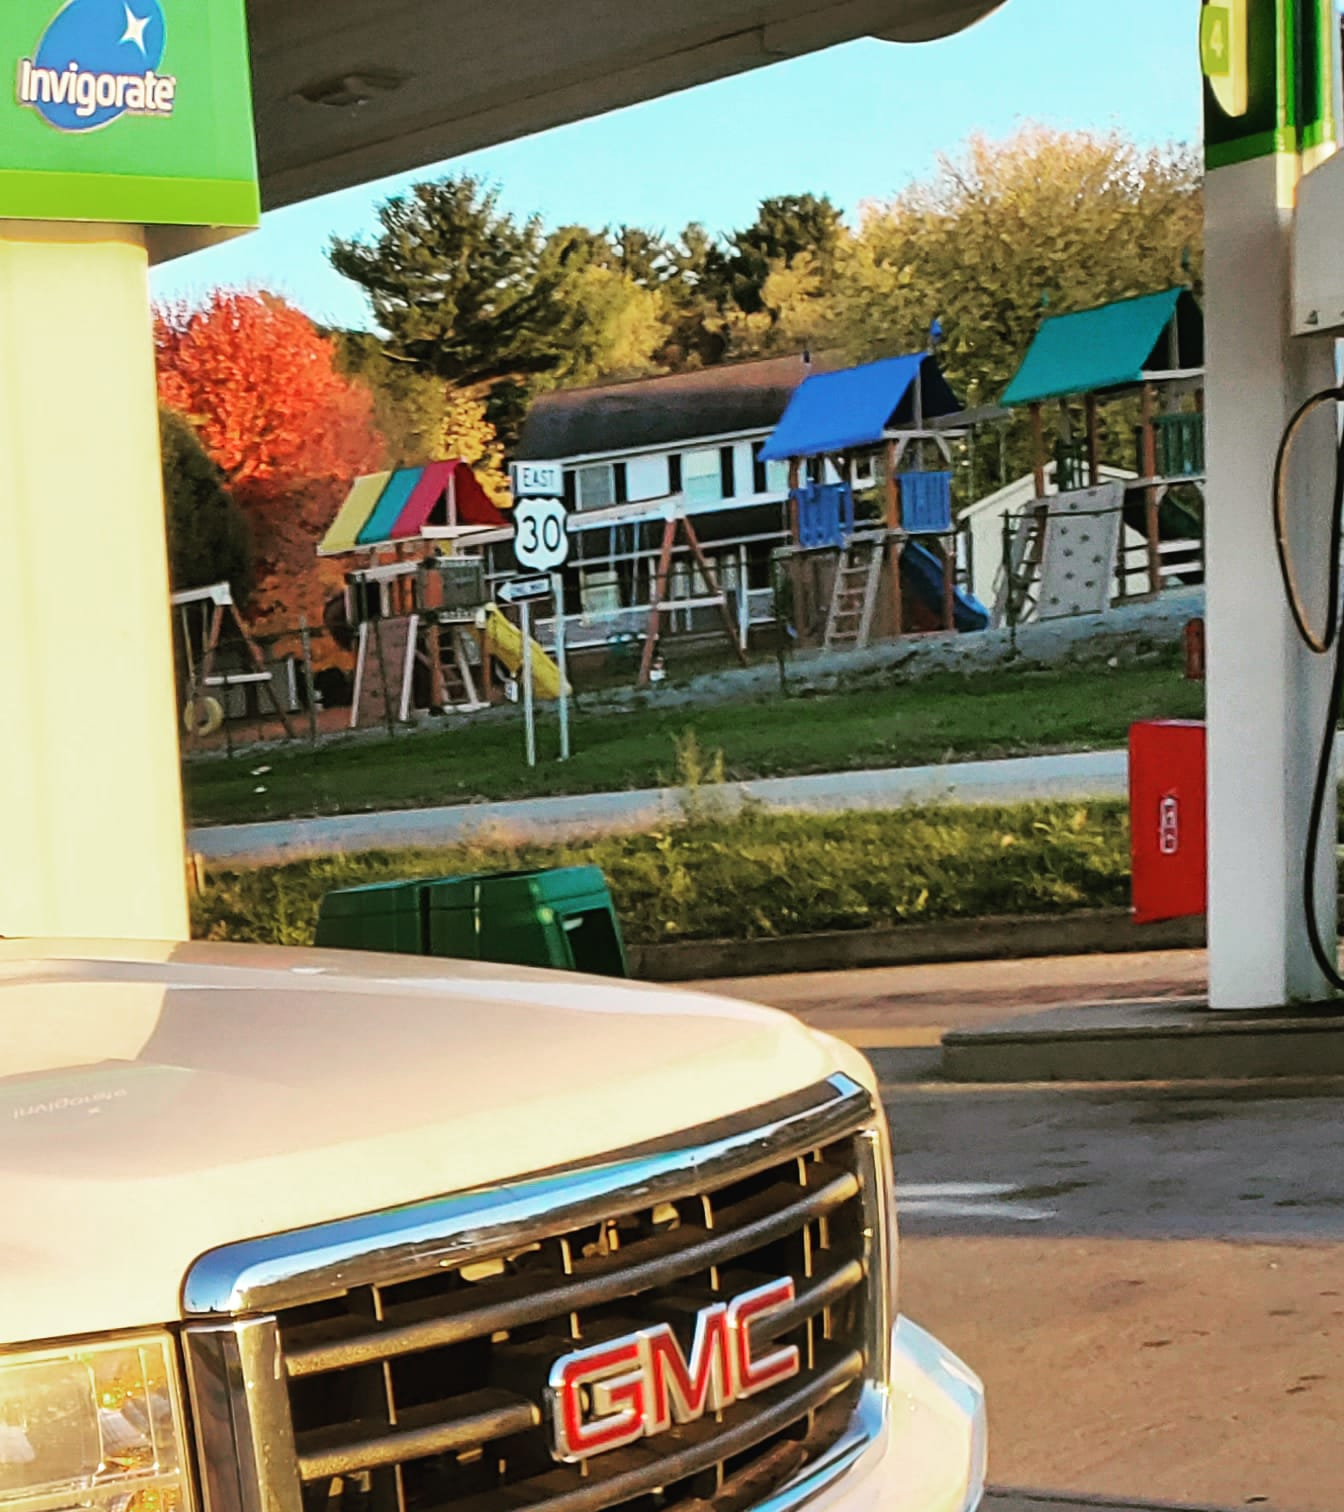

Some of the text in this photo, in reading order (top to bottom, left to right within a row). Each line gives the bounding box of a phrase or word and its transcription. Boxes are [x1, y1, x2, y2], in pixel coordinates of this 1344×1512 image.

[1210, 19, 1224, 58] 4
[20, 58, 175, 117] Invigorate
[522, 467, 555, 488] EAST
[522, 514, 561, 553] 30
[548, 1275, 799, 1463] GMC
